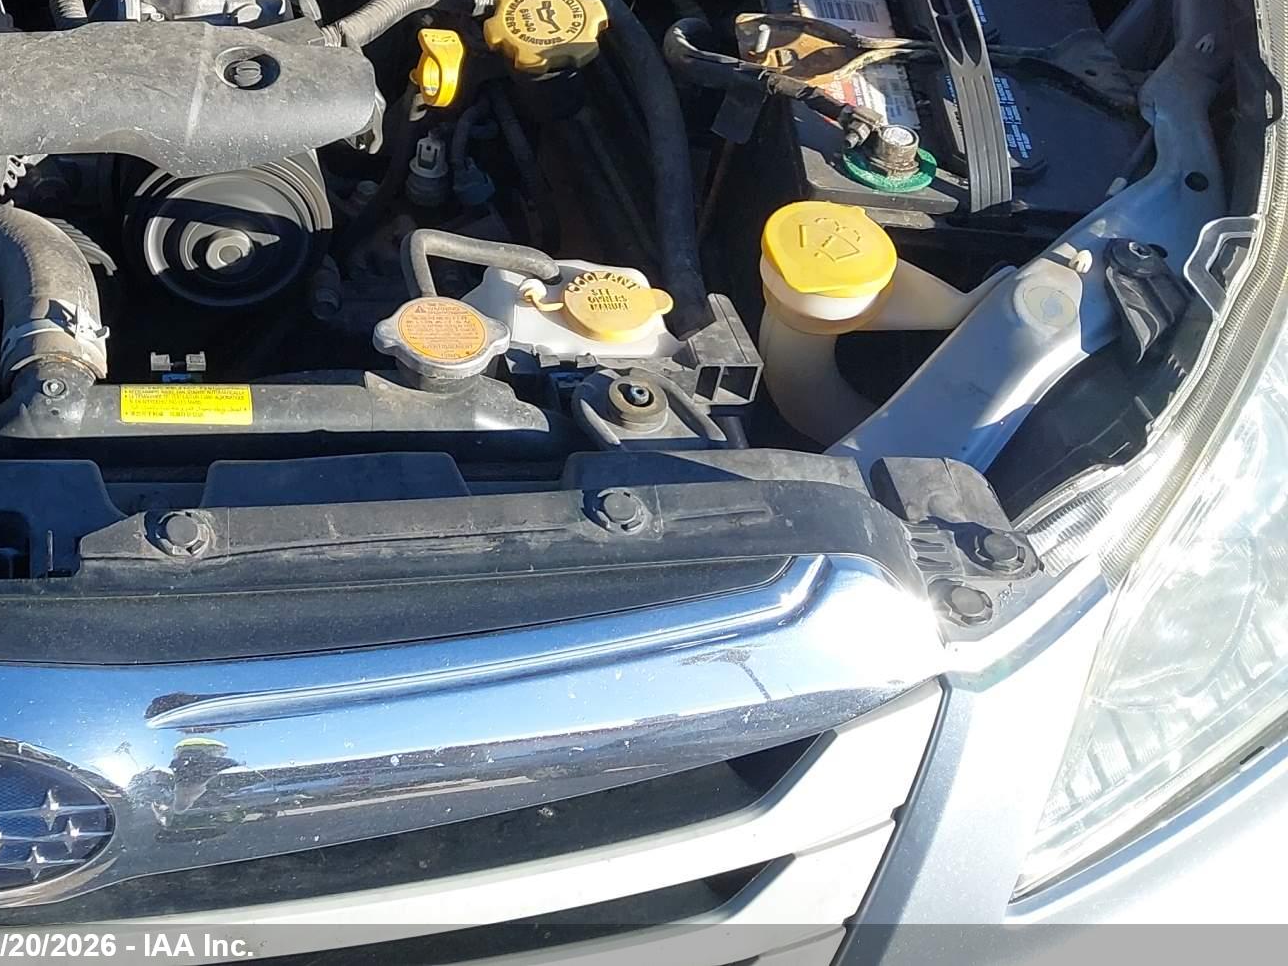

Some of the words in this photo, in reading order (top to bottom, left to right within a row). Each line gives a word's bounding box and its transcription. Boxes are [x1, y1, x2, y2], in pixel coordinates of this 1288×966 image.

[566, 20, 583, 35] OIL
[518, 33, 566, 45] MANUAL
[568, 271, 641, 294] COOLANT
[588, 302, 630, 312] MANUAL
